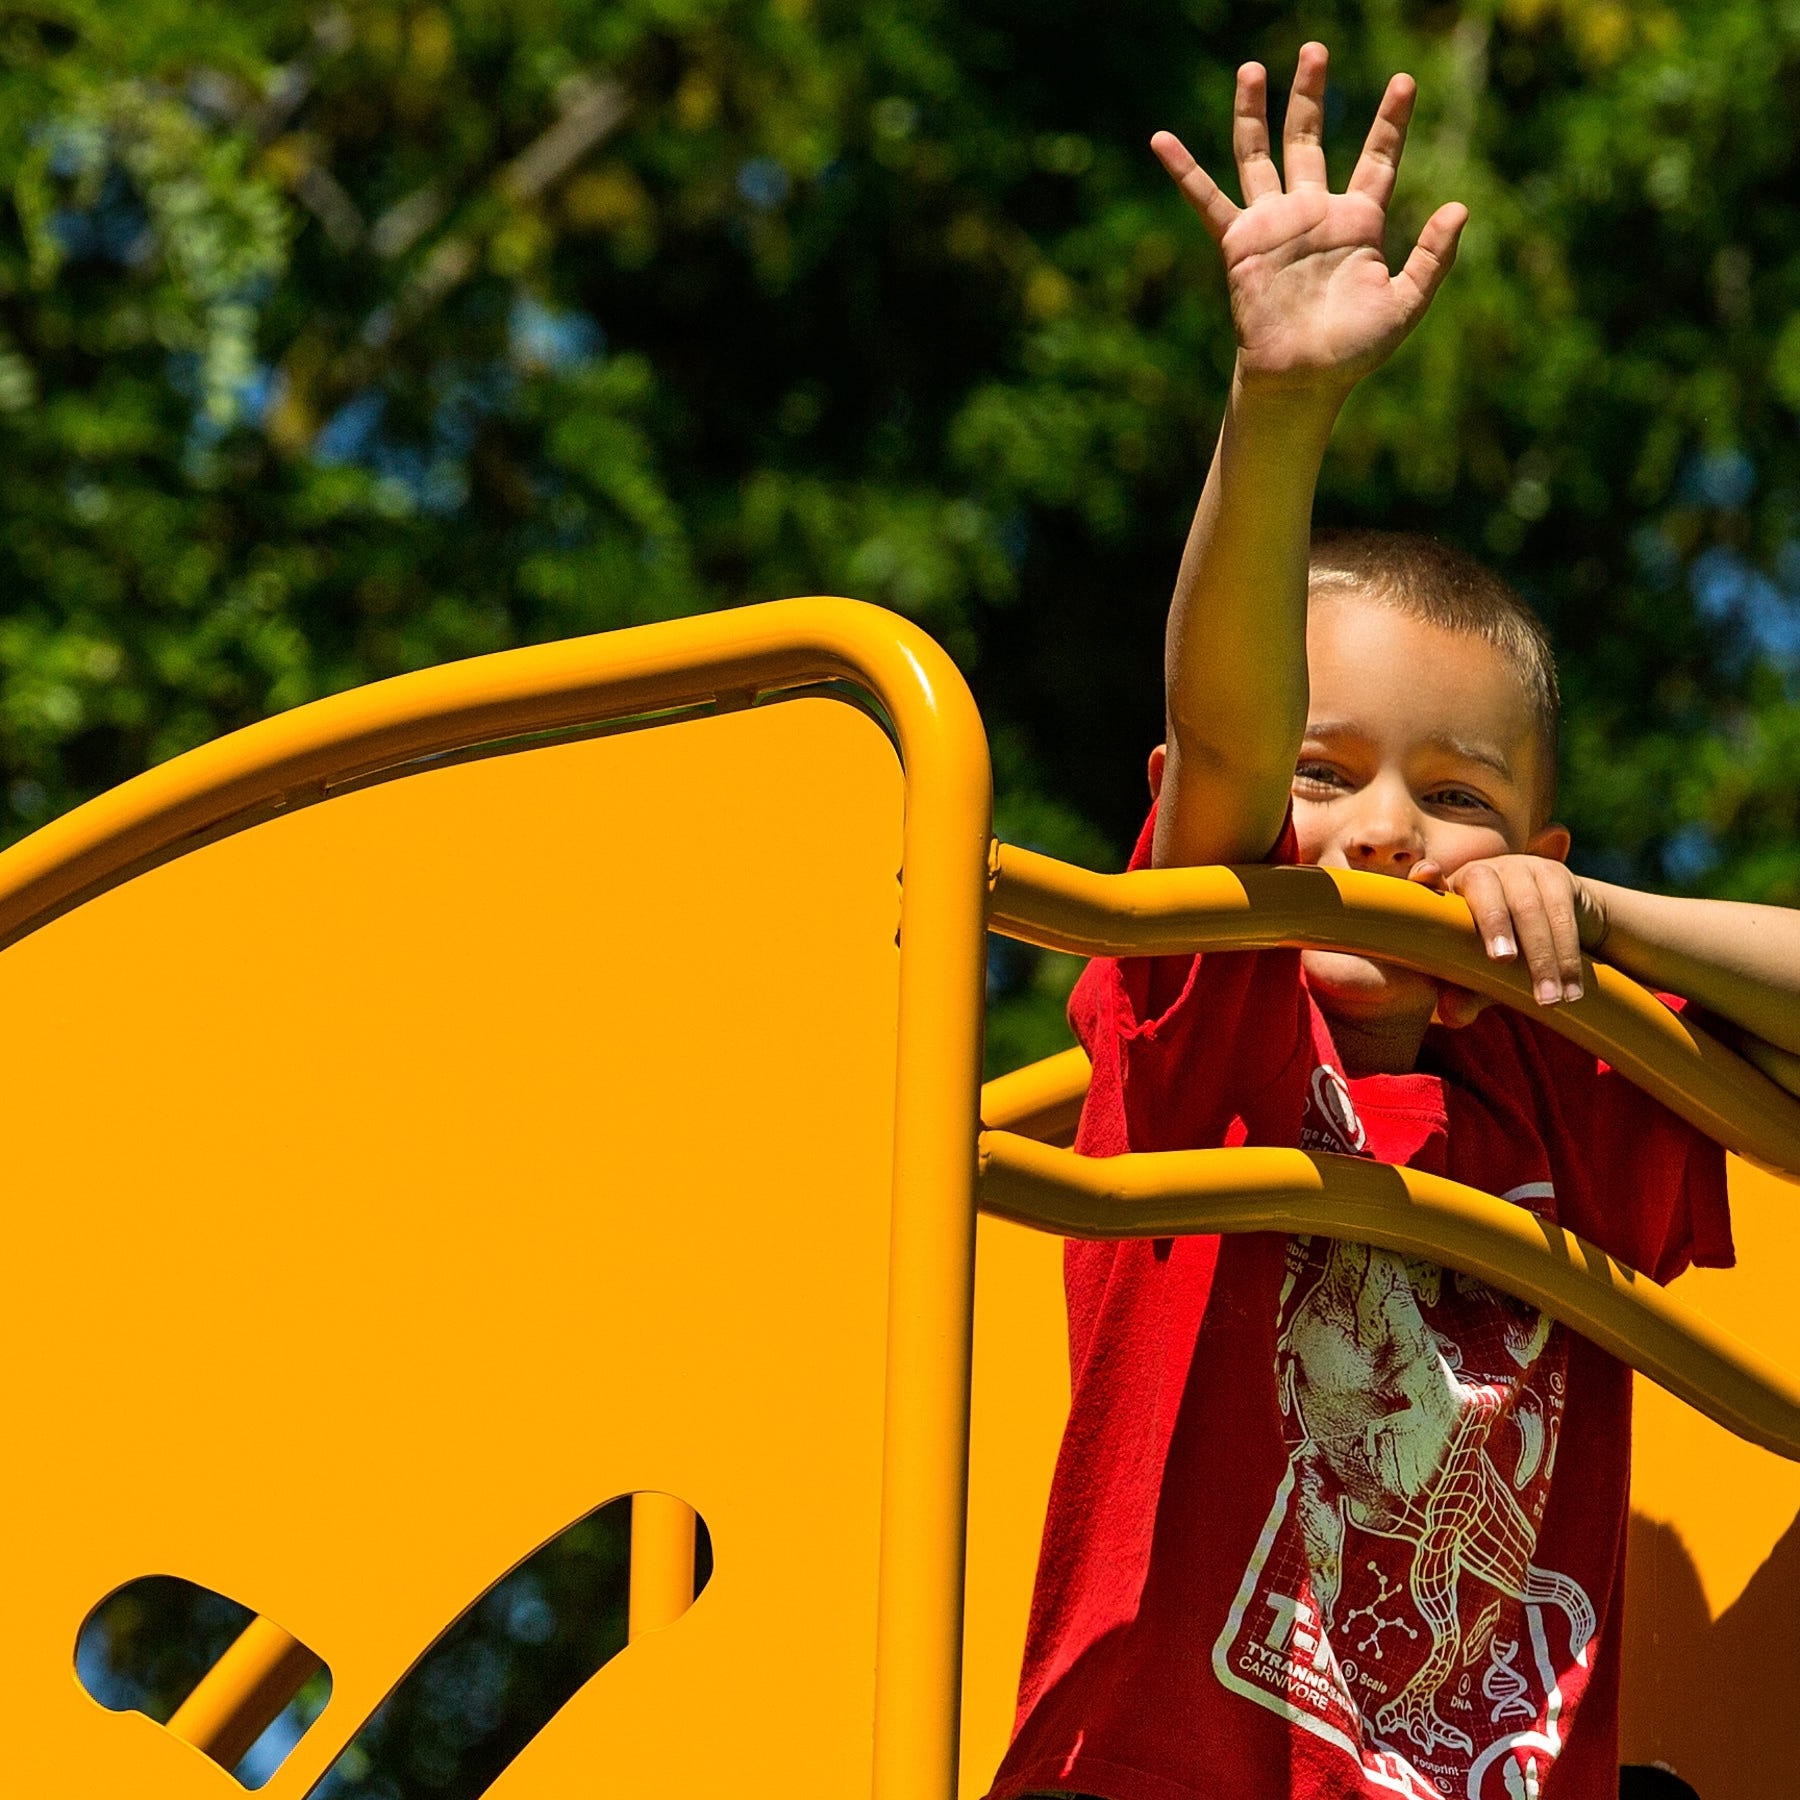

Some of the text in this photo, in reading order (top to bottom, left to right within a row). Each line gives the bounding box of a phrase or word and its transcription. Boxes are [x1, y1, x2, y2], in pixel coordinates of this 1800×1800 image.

[1239, 1656, 1329, 1711] CARNIVORE
[1248, 1641, 1354, 1718] TYRANNOSAU
[1359, 1672, 1388, 1694] Scale
[1450, 1695, 1473, 1711] DNA
[1413, 1754, 1460, 1777] Footprint
